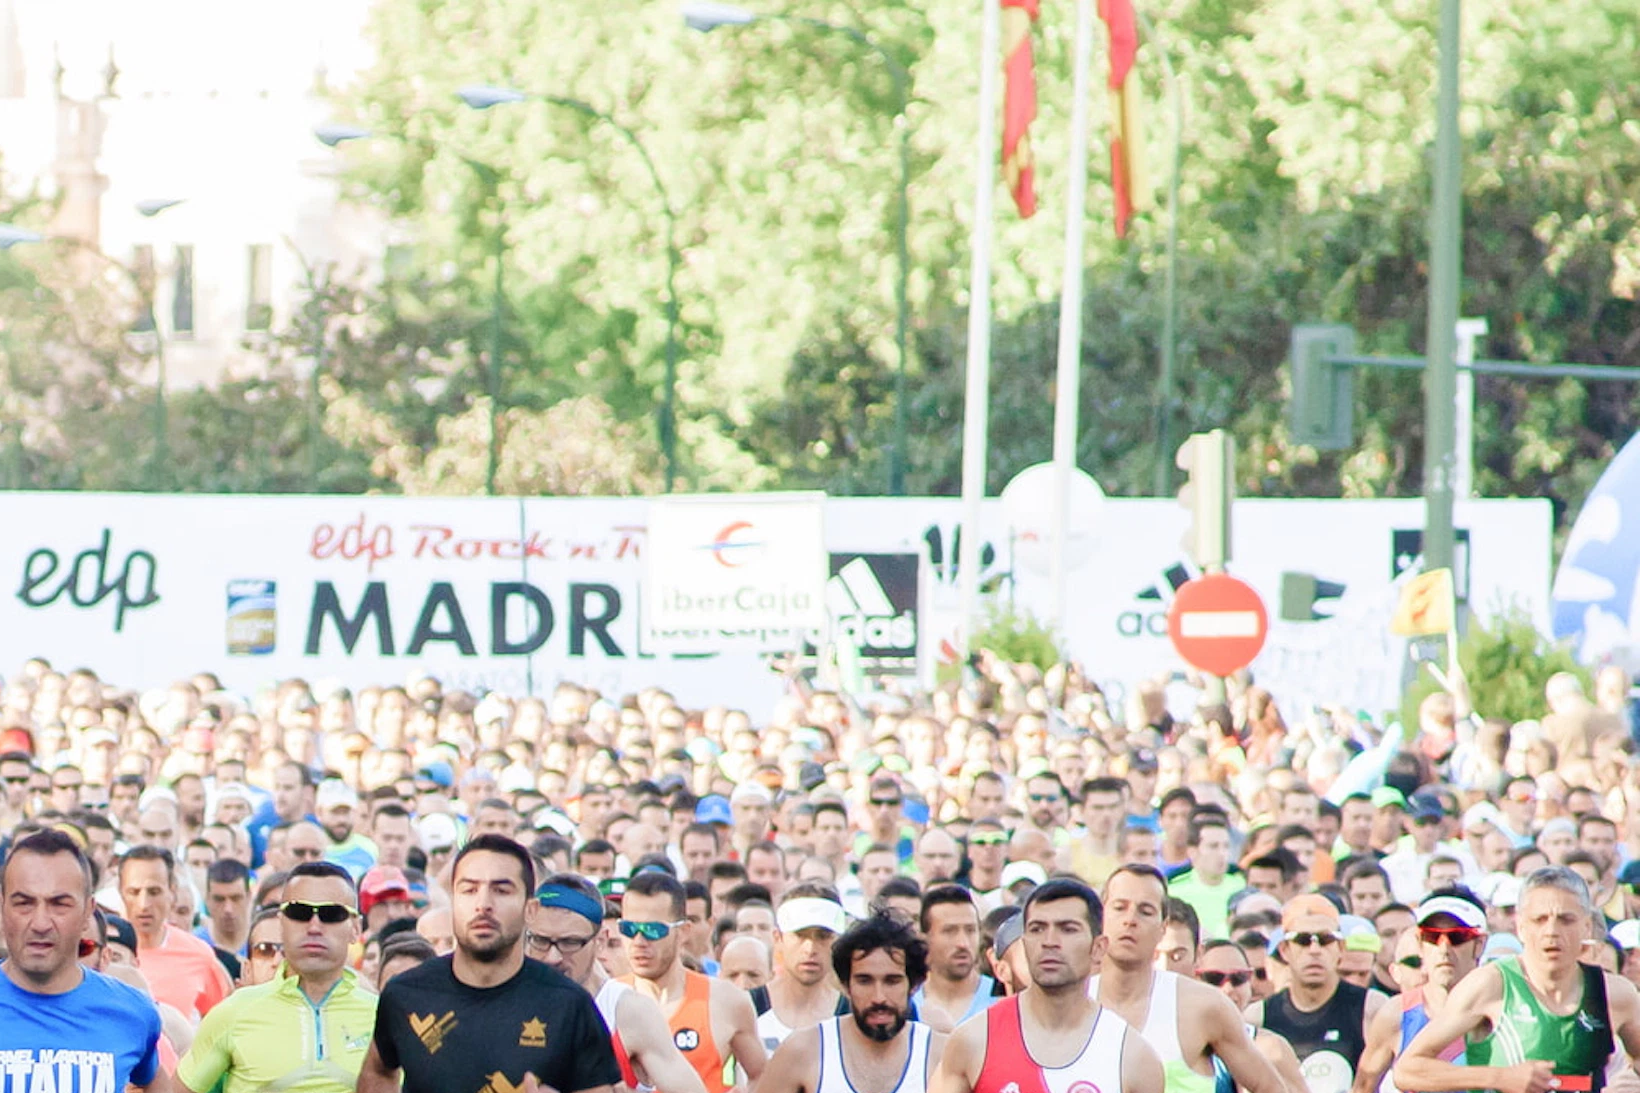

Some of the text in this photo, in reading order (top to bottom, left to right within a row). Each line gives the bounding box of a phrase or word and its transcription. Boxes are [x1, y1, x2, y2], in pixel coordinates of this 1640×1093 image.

[17, 527, 161, 631] edp
[310, 511, 394, 573] edp
[409, 525, 555, 560] Rock
[304, 580, 720, 658] MADR
